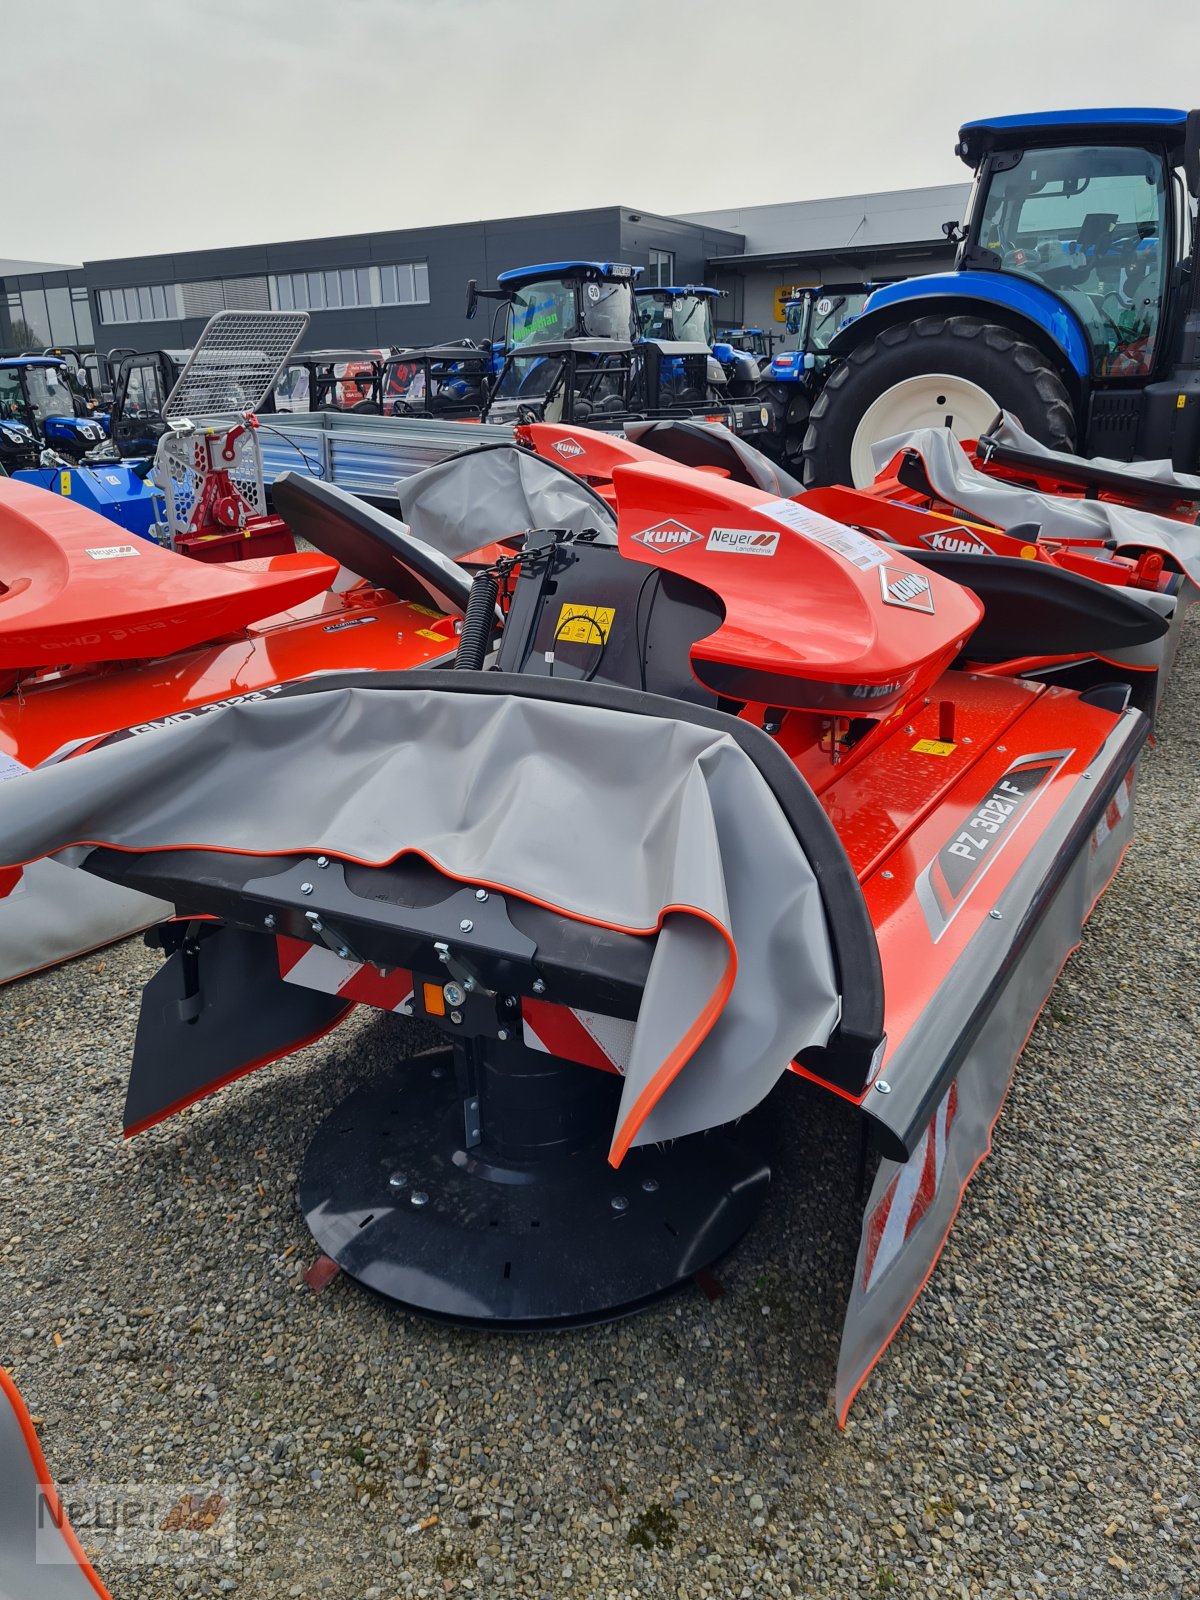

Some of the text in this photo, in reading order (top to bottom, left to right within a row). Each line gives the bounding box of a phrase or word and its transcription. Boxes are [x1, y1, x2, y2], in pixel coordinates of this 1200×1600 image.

[589, 287, 599, 298] 50
[819, 302, 829, 313] 40
[556, 442, 581, 455] KUHN
[643, 531, 692, 543] KUHN
[710, 530, 752, 546] Neyer
[735, 546, 773, 555] Landtechnik
[931, 534, 985, 555] KUHN
[887, 573, 929, 602] KUHN
[947, 780, 1025, 861] PZ 3021 F
